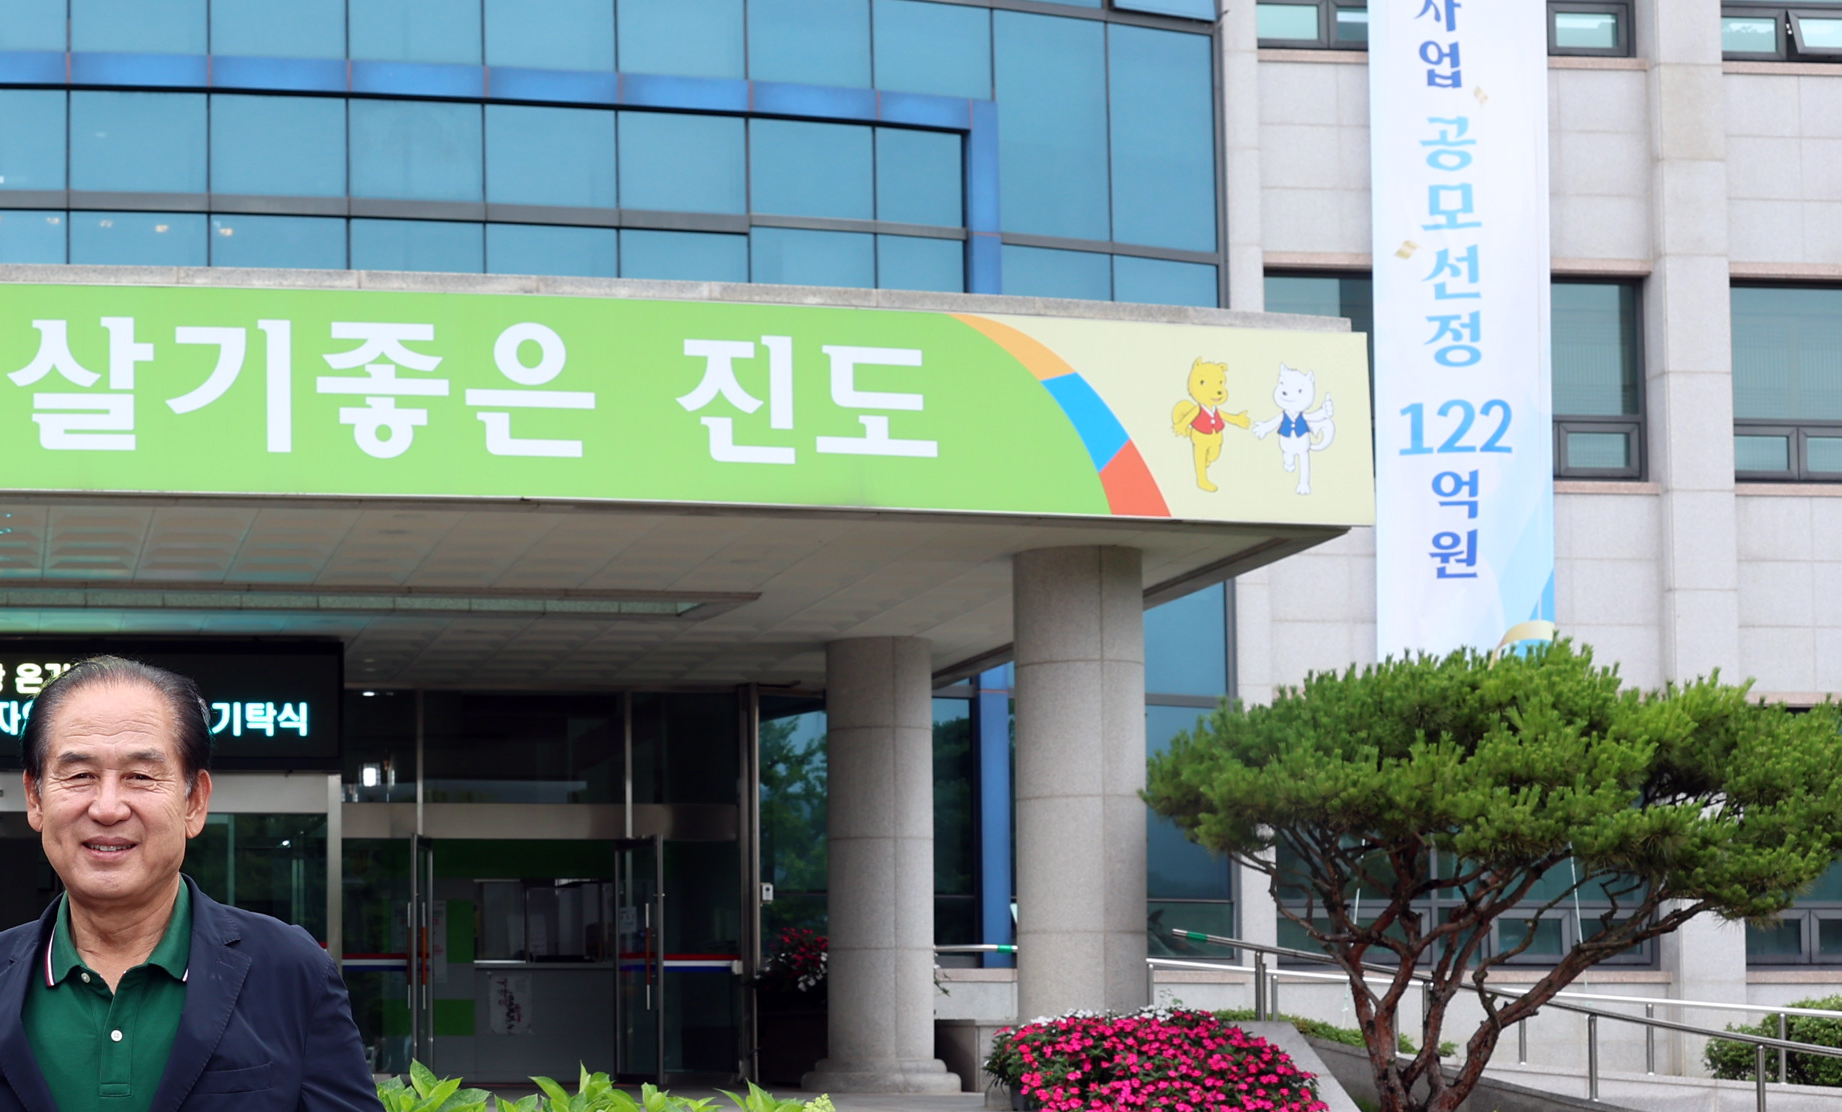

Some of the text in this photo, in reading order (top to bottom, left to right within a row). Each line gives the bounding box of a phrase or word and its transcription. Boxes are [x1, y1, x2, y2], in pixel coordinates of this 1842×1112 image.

[1414, 0, 1482, 368] 사업 공모선정
[8, 318, 594, 458] 살기좋은
[677, 336, 937, 464] 진도
[211, 702, 308, 737] 기탁식
